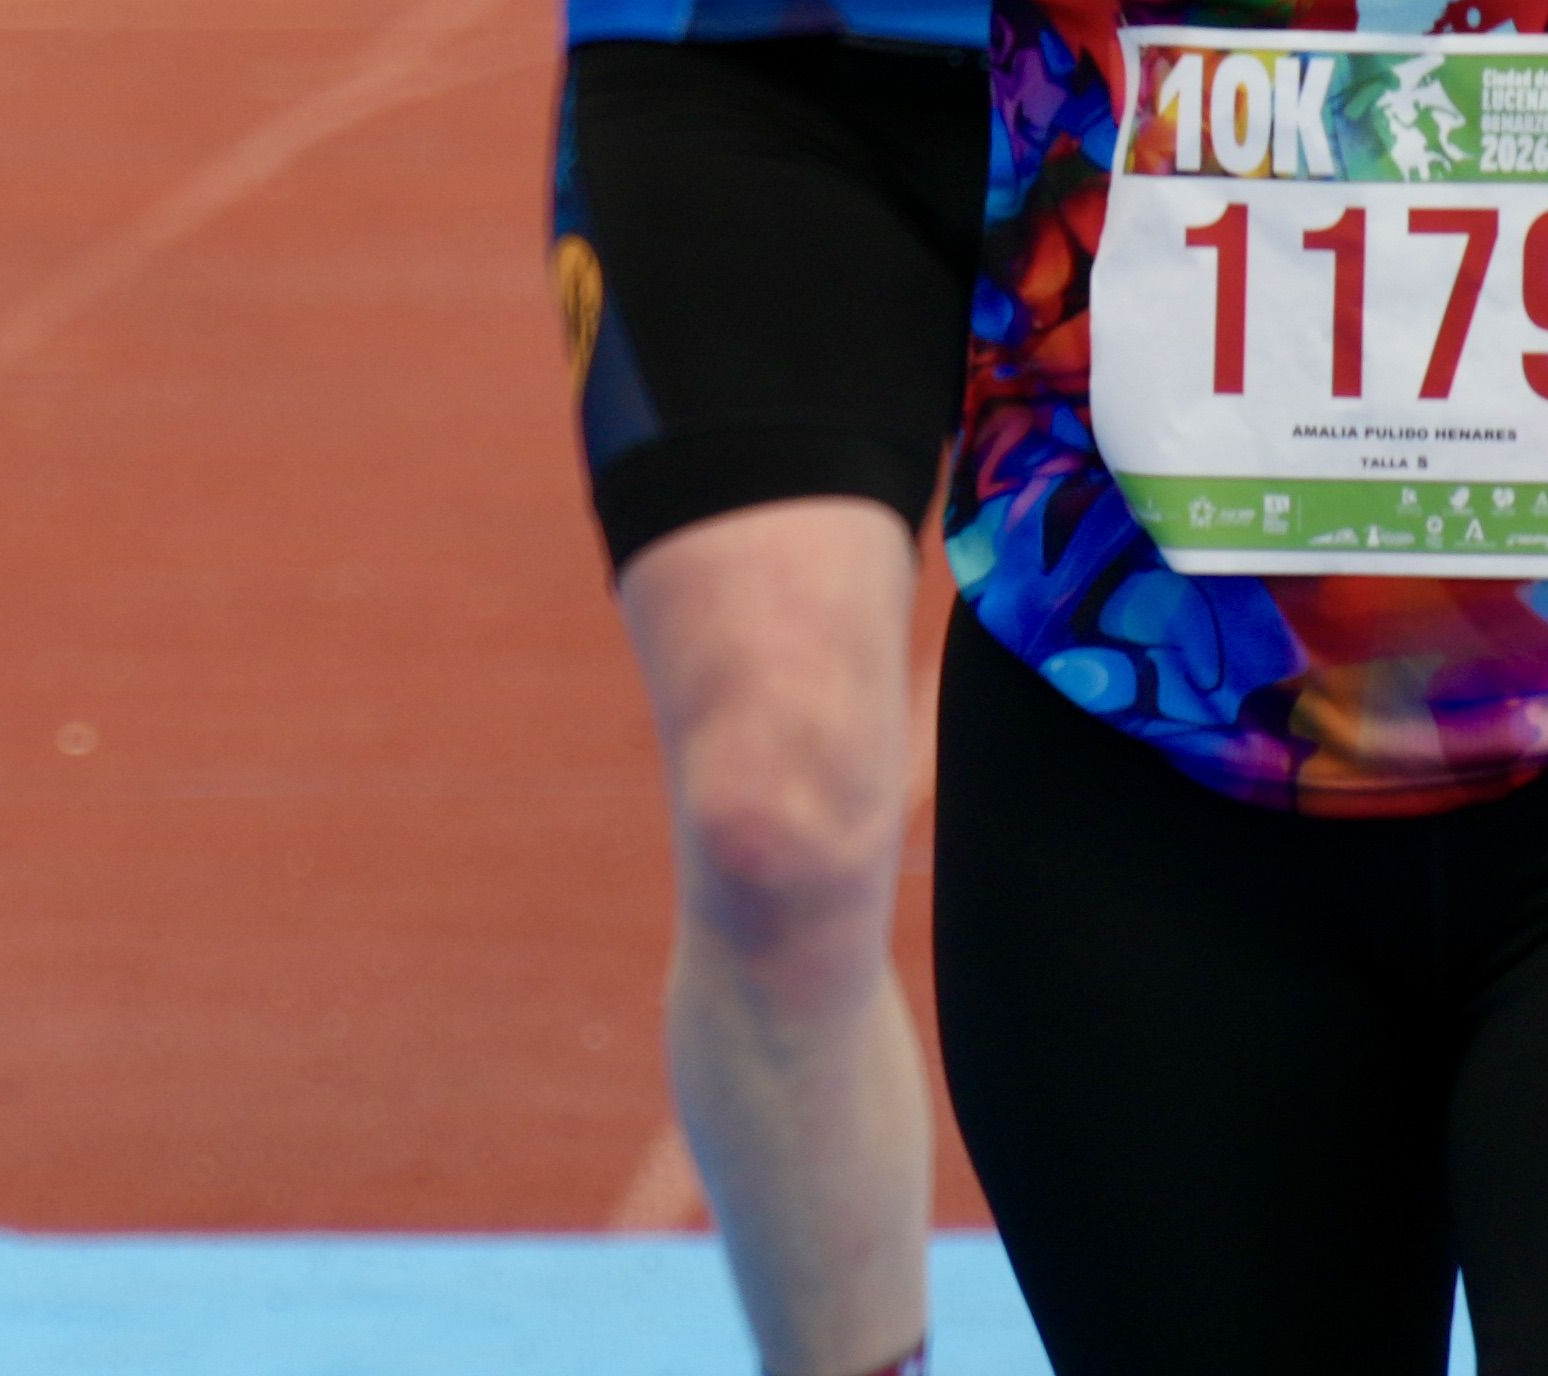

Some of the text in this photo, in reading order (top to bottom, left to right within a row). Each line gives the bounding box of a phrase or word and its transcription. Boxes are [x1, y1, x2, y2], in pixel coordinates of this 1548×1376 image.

[1159, 53, 1336, 176] 10K
[1292, 424, 1518, 441] AMALIA PULIDO HENARES
[1361, 456, 1408, 470] TALLA
